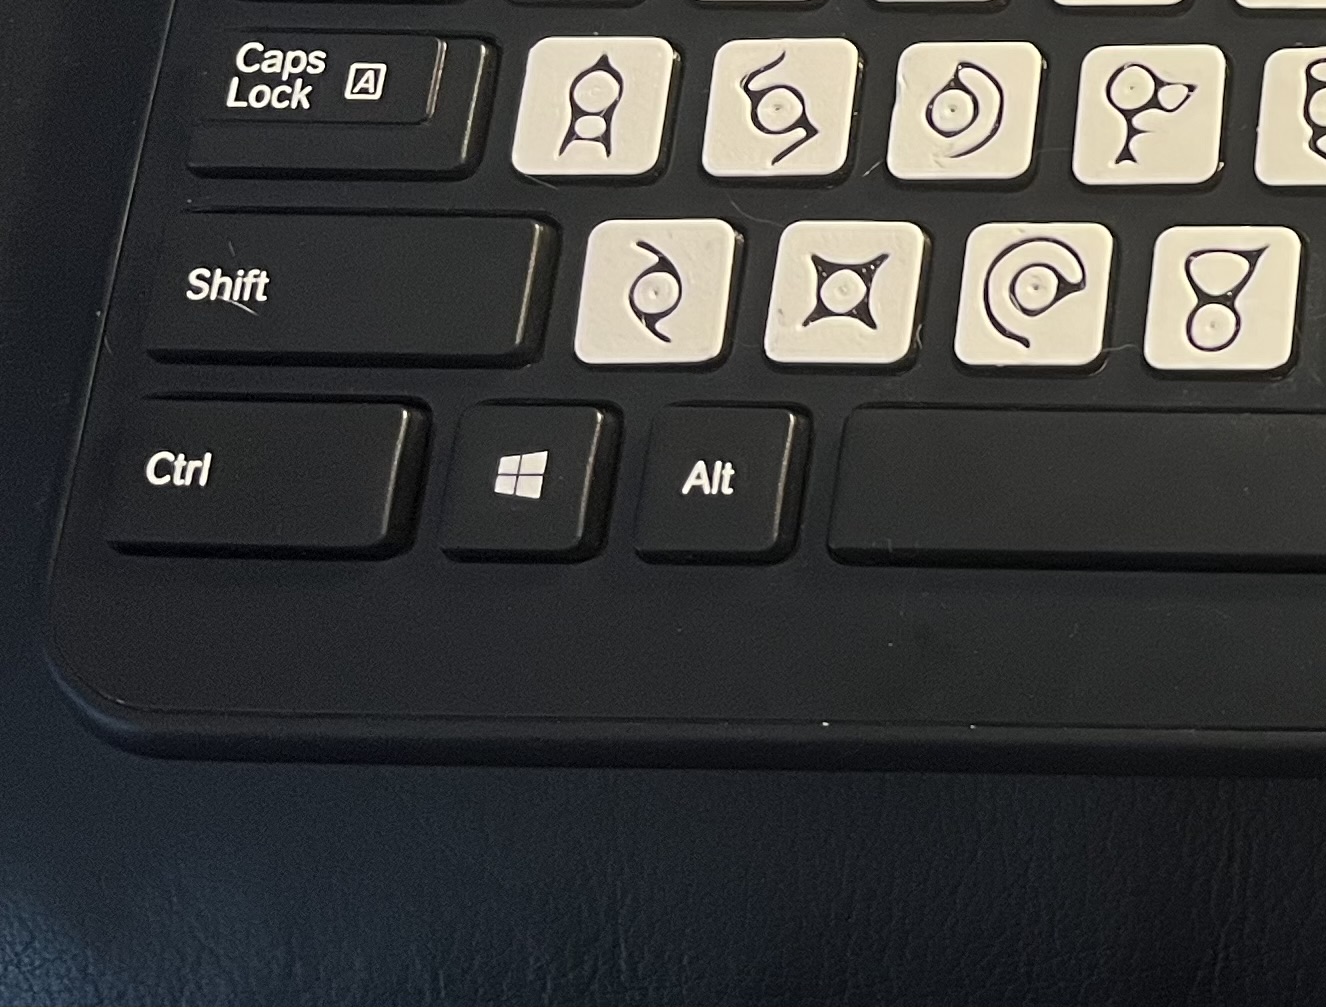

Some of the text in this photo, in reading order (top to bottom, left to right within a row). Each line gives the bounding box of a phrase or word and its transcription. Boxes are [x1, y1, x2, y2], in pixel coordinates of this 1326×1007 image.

[234, 42, 327, 80] Caps
[226, 77, 312, 110] Lock
[352, 68, 378, 95] A
[185, 268, 270, 303] Shift
[145, 451, 212, 487] Ctrl
[682, 461, 734, 495] Alt
